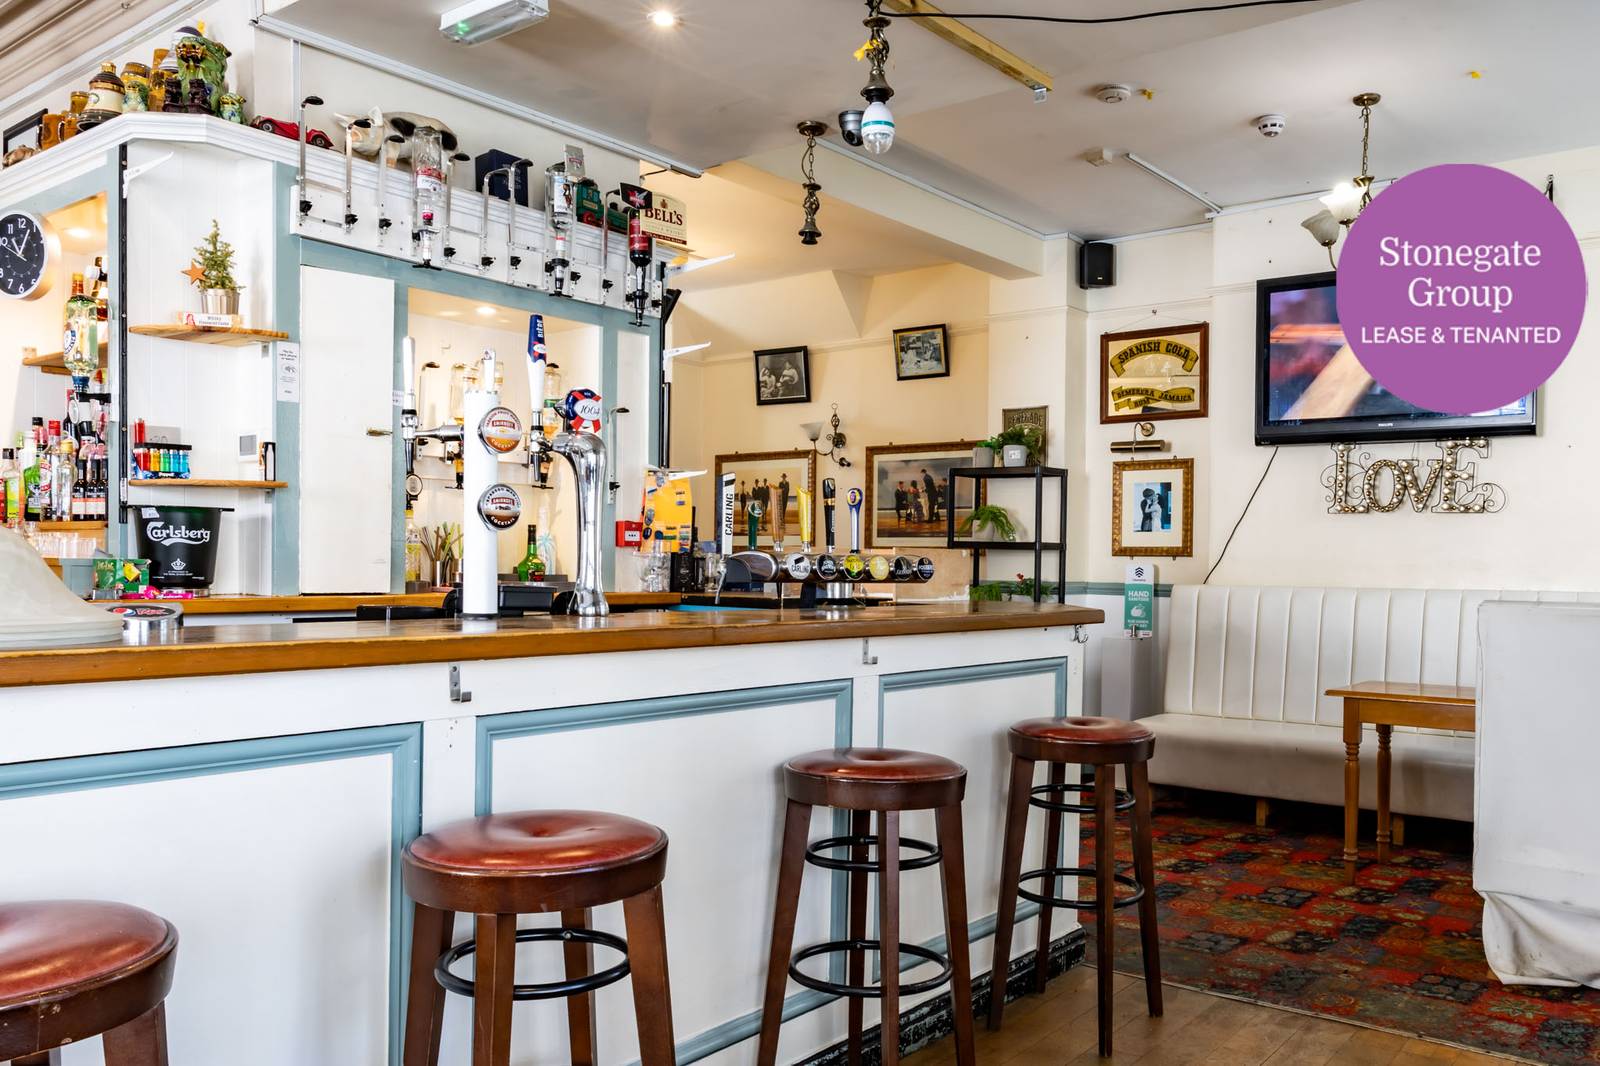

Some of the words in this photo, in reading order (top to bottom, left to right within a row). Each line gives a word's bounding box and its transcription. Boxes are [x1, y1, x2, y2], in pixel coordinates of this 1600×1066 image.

[18, 218, 26, 229] 12
[644, 207, 683, 226] BELL'S
[7, 224, 14, 235] 11
[7, 279, 14, 290] 7
[18, 283, 25, 294] 6
[1118, 341, 1161, 364] SPANISH
[1165, 342, 1190, 360] GOLD
[1327, 436, 1490, 514] LOVE
[725, 492, 734, 536] CARLING
[146, 521, 211, 546] Carlsberg
[1128, 590, 1150, 598] HAND
